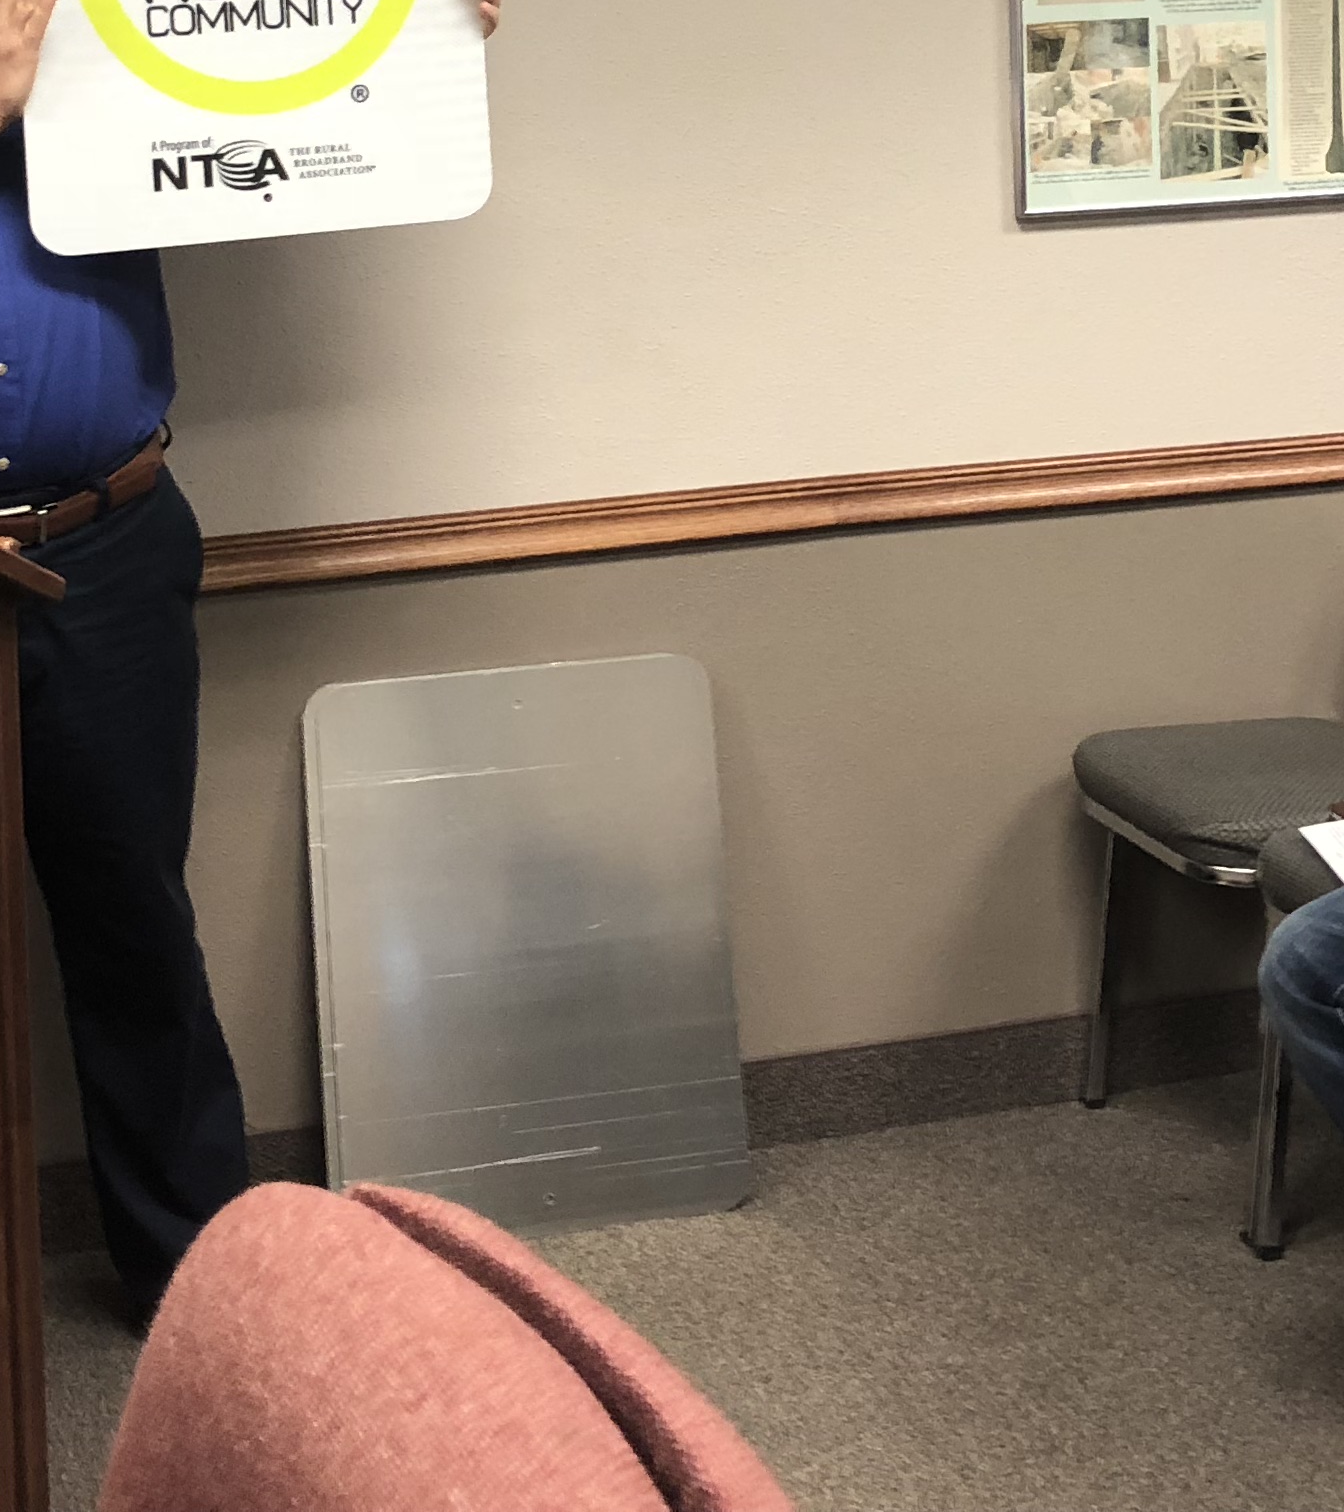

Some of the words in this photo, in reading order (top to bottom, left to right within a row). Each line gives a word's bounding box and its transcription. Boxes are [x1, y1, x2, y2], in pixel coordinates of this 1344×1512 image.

[159, 140, 200, 153] Program
[289, 147, 312, 157] THE
[314, 143, 352, 155] RURAL
[293, 154, 364, 168] BROADBAND
